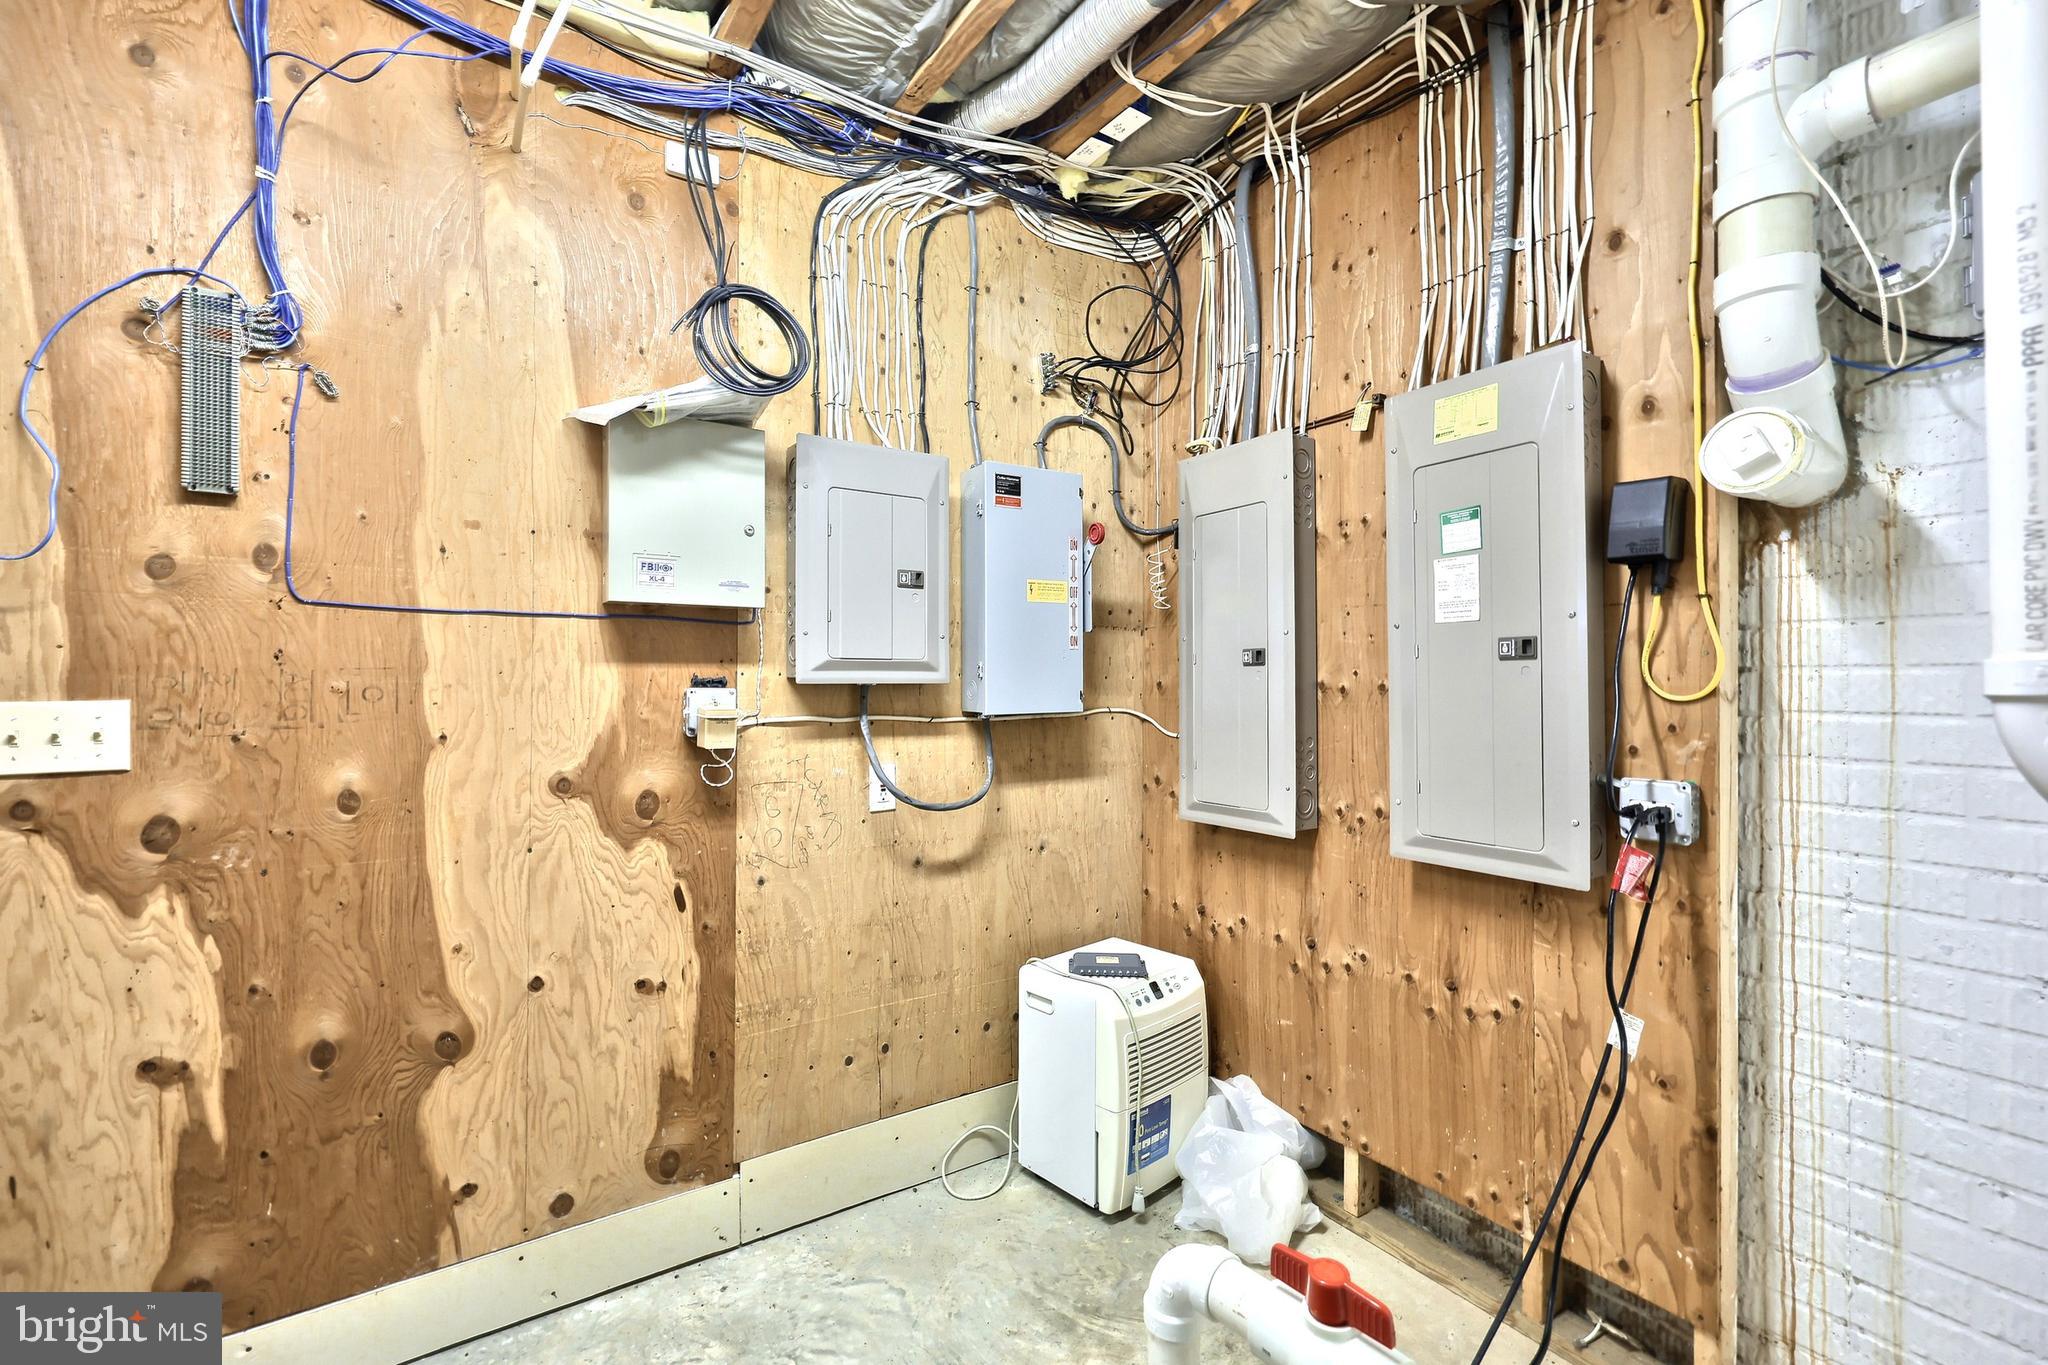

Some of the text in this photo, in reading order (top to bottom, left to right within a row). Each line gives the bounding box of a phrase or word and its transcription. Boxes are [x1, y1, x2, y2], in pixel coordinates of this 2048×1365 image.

[1069, 539, 1078, 551] ON
[2023, 519, 2046, 551] DWV
[2023, 553, 2046, 582] PVC
[1069, 586, 1078, 599] OFF
[2024, 586, 2047, 620] CORE
[1069, 635, 1078, 647] ON
